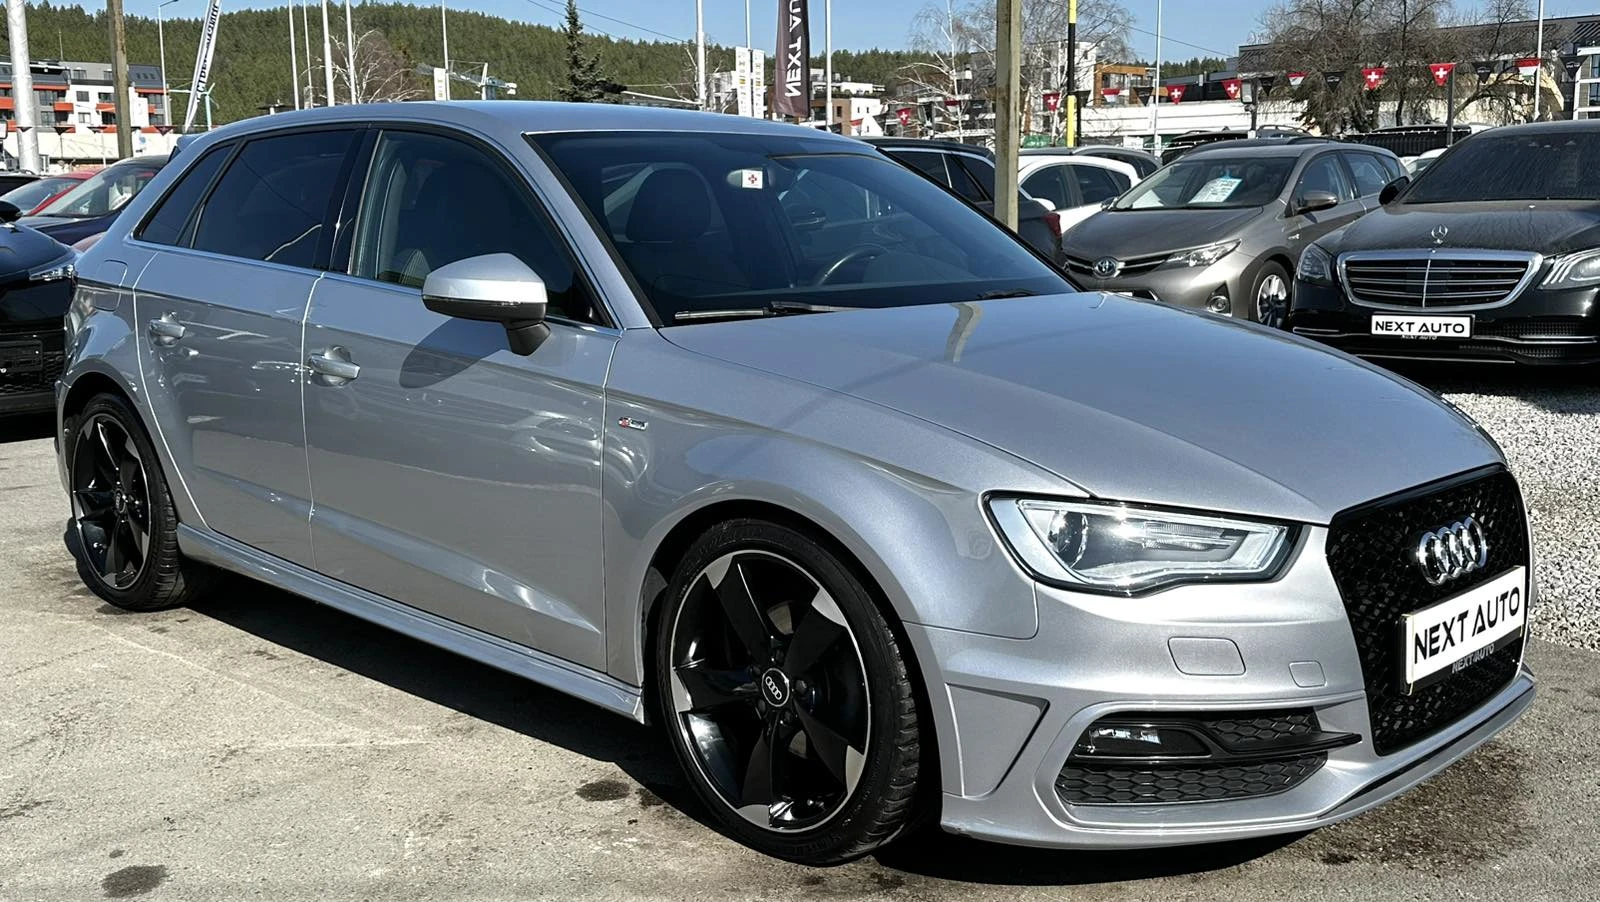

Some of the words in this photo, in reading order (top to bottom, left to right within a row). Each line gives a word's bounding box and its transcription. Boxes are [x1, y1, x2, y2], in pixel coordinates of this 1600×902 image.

[784, 36, 802, 97] NEXT
[1375, 321, 1415, 332] NEXT
[1418, 322, 1465, 334] AUTO
[1415, 610, 1469, 664] NEXT
[1471, 587, 1520, 637] AUTO
[1452, 654, 1473, 674] NEXT
[1472, 643, 1495, 663] AUTO
